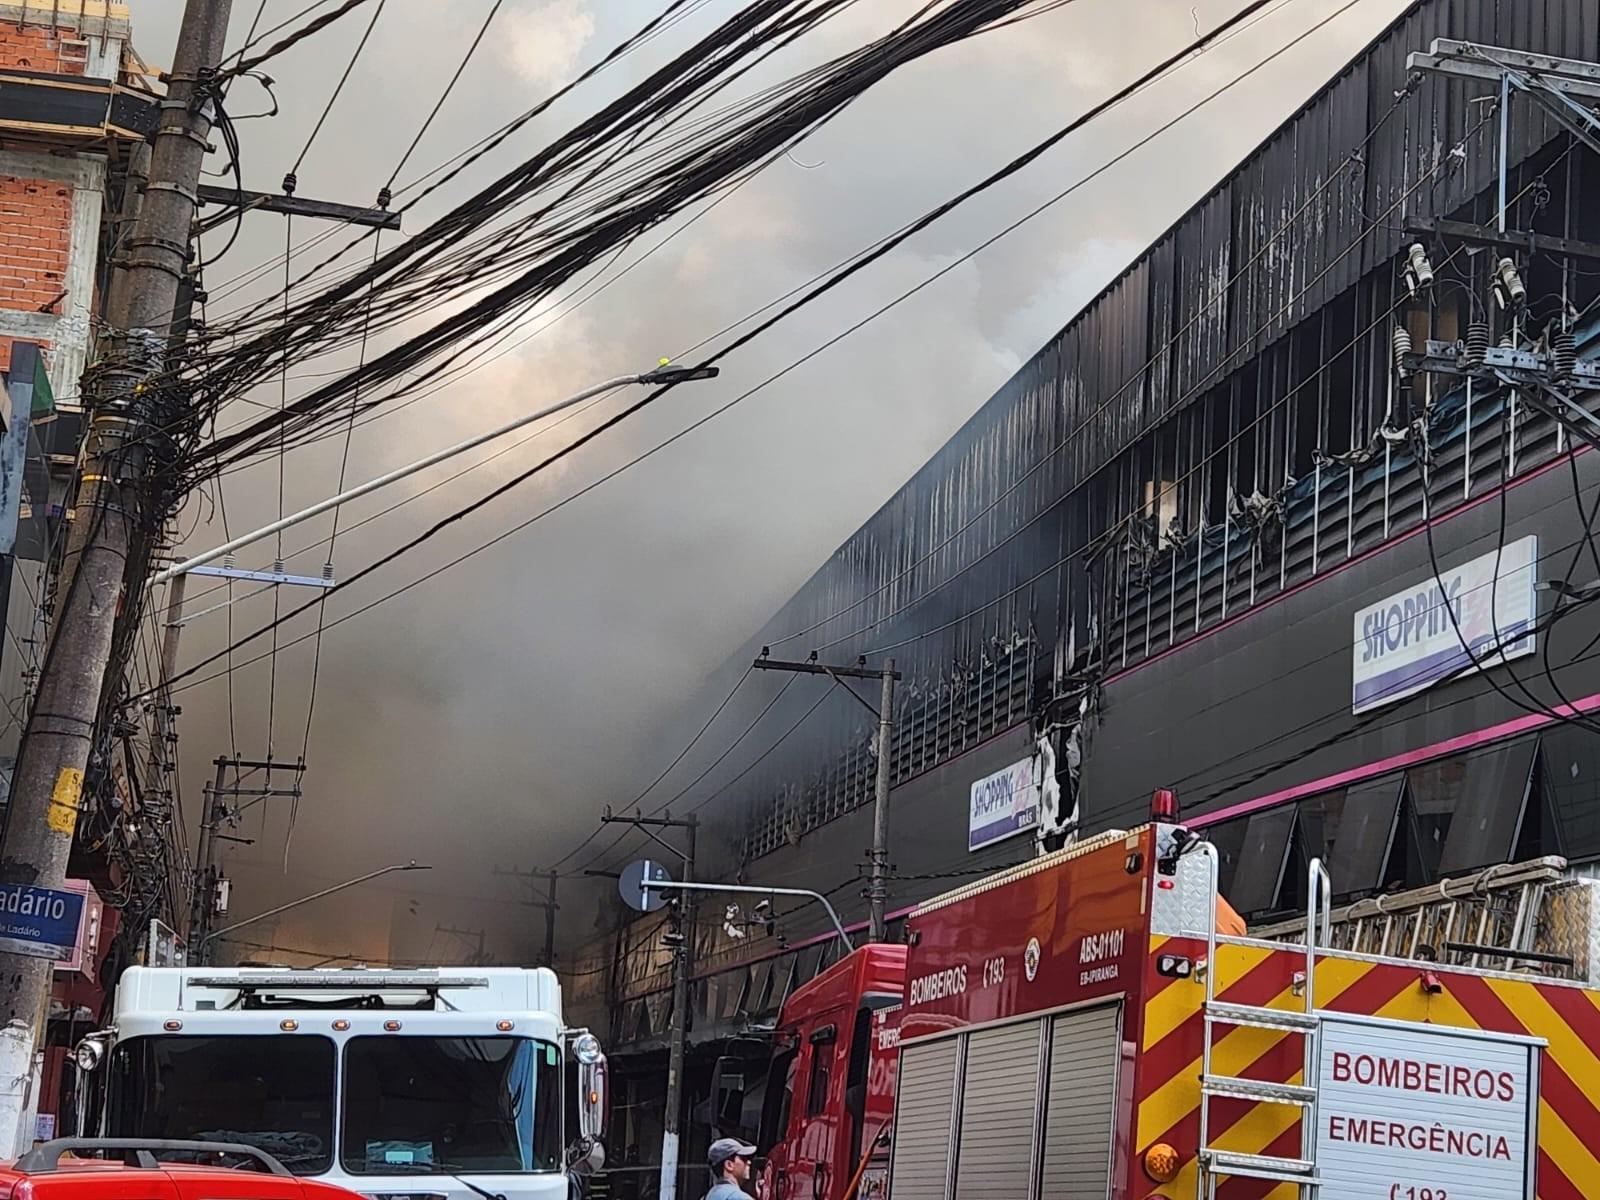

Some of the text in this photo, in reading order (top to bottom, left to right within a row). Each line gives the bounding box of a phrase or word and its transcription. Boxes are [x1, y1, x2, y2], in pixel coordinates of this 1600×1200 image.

[1362, 575, 1462, 663] SHOPPING
[974, 770, 1014, 819] SHOPPING
[7, 924, 41, 937] Ladário
[1079, 927, 1125, 965] ABS-01101
[909, 956, 1005, 1007] BOMBEIROS 193
[1079, 963, 1119, 986] EB-IPIRANGA
[1333, 1051, 1514, 1102] BOMBEIROS
[1328, 1115, 1512, 1161] EMERGÊNCIA
